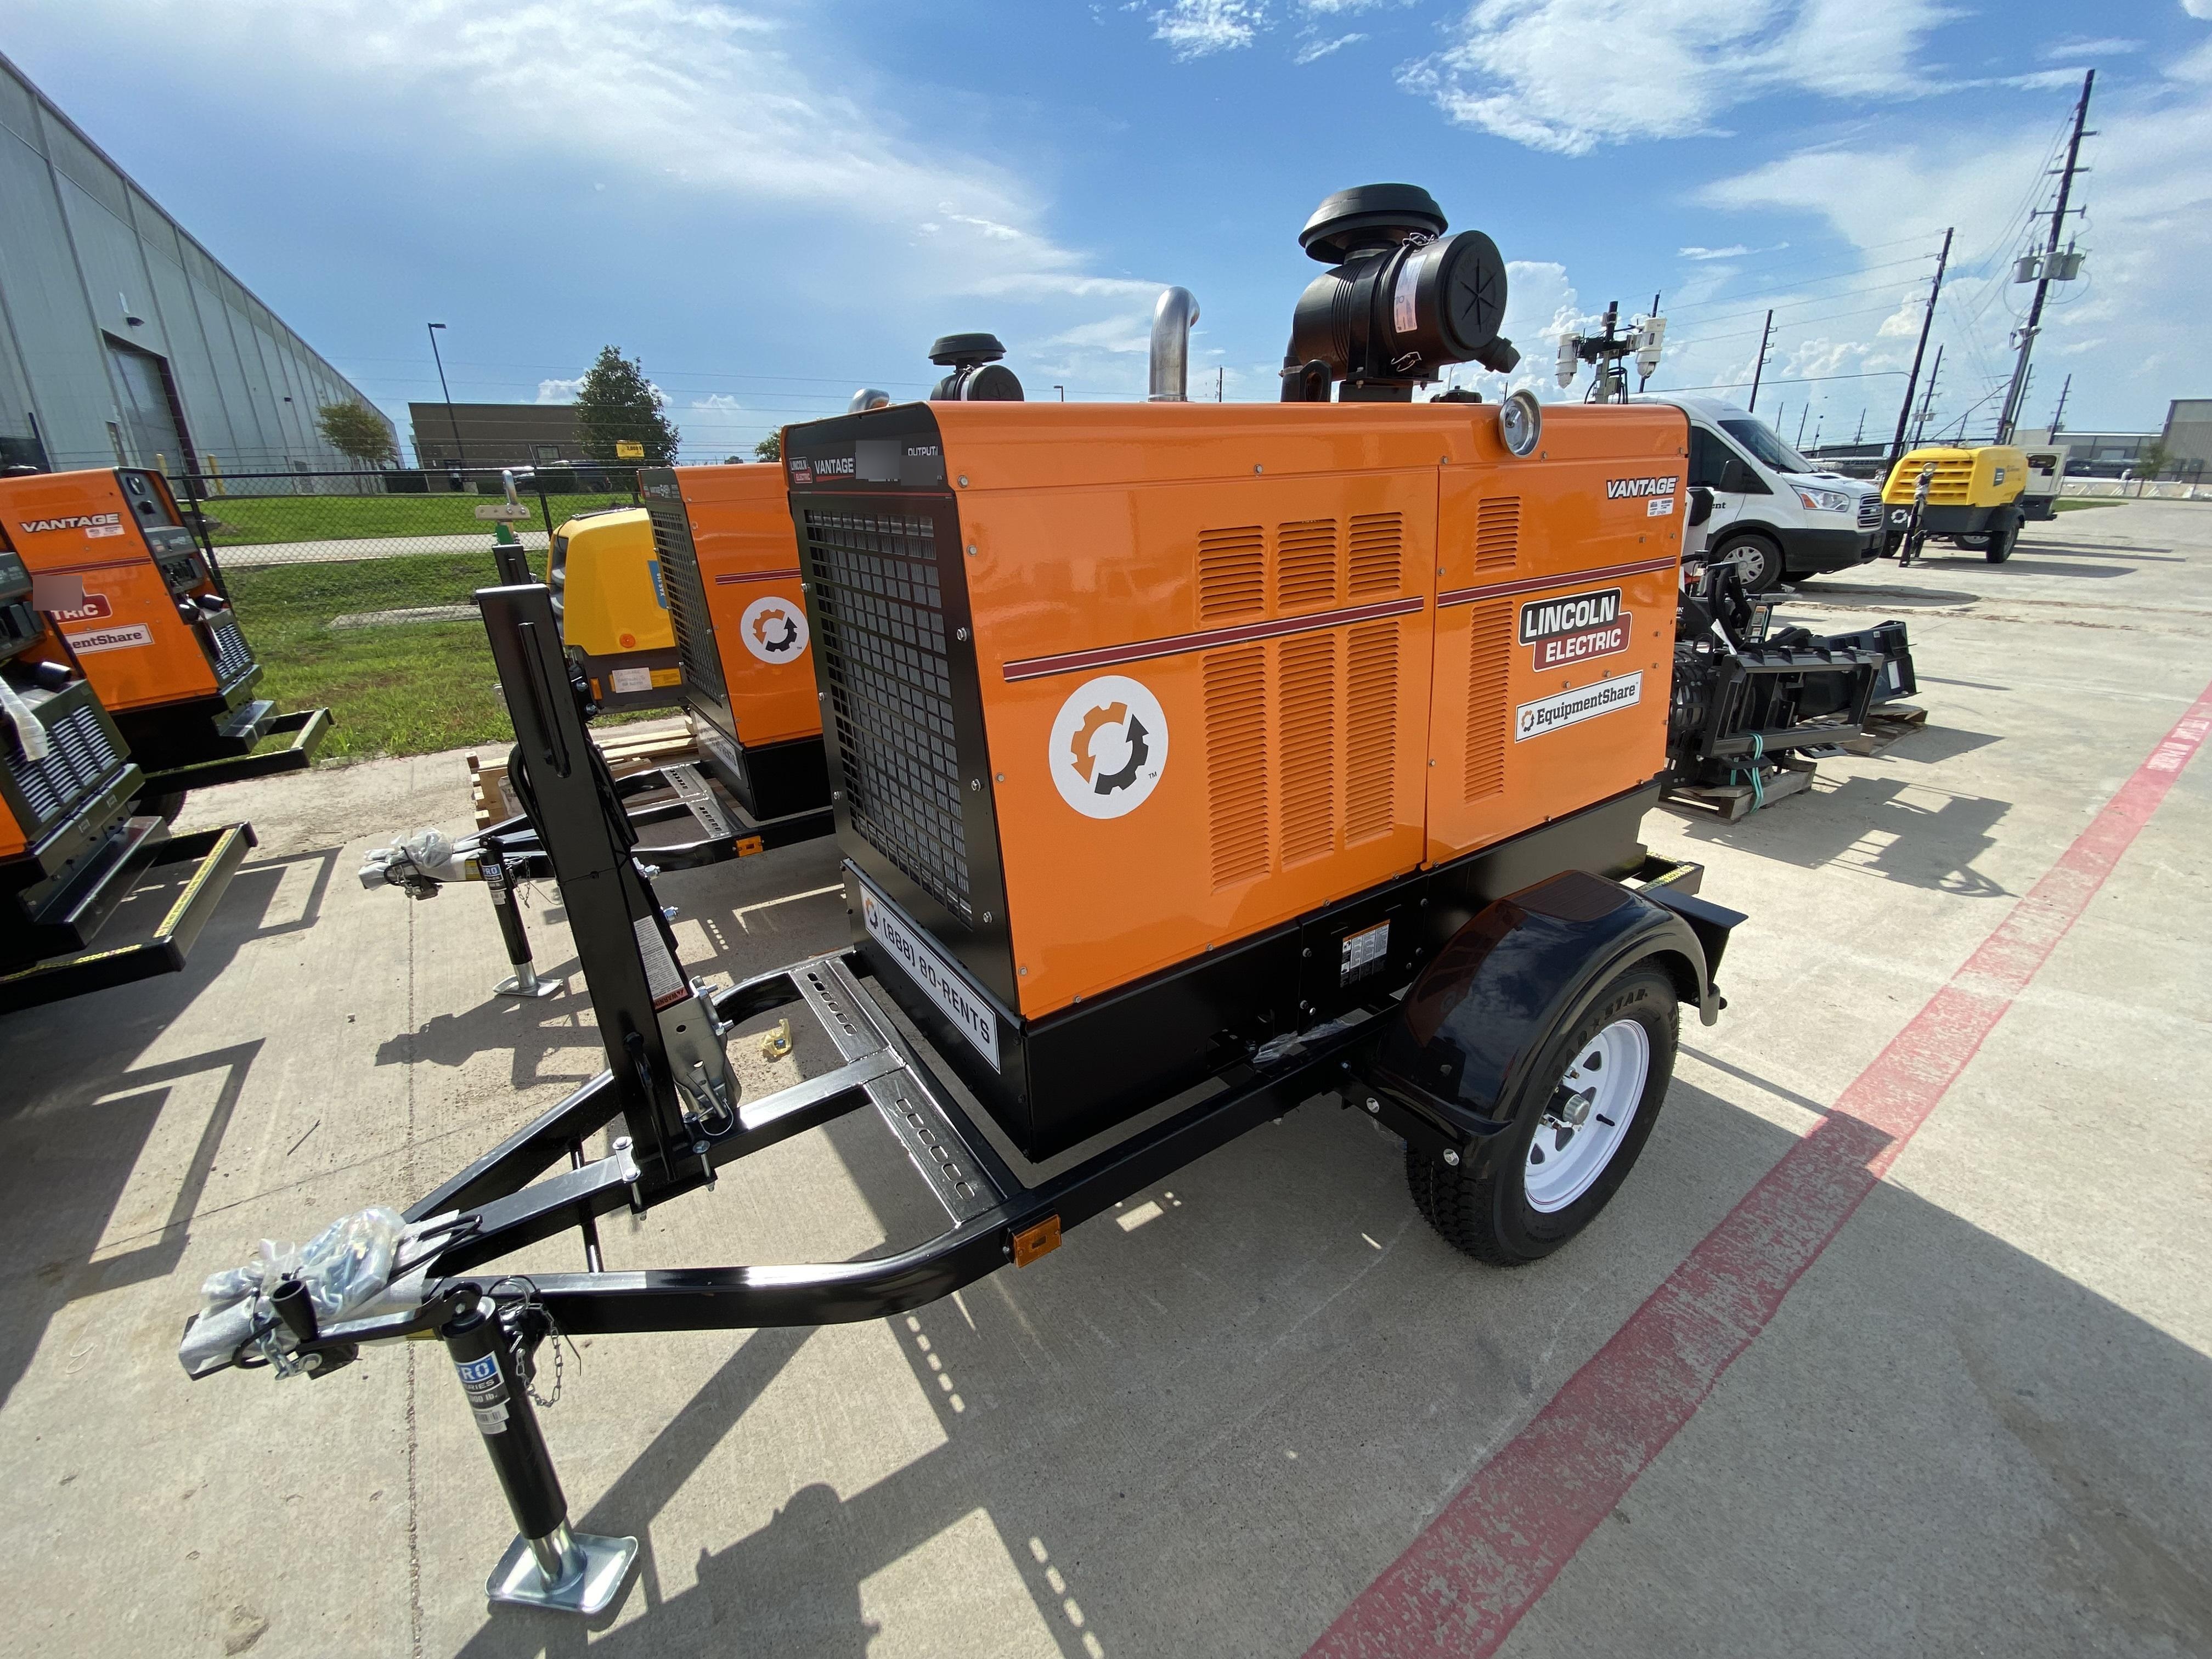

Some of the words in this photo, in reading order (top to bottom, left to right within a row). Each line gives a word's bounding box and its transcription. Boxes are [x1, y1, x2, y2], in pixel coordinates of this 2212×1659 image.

[790, 460, 807, 471] LINCOLN
[815, 458, 854, 475] VANTAGE
[795, 472, 810, 481] ELECTRIC
[1607, 477, 1677, 498] VANTAGE
[20, 513, 119, 532] VANTAGE
[1526, 595, 1616, 637] LINCOLN
[1545, 628, 1622, 663] ELECTRIC
[1537, 684, 1635, 725] EquipmentShare
[1148, 771, 1157, 779] TM
[883, 917, 915, 967] (888)
[919, 955, 990, 1045] 80-RENTS
